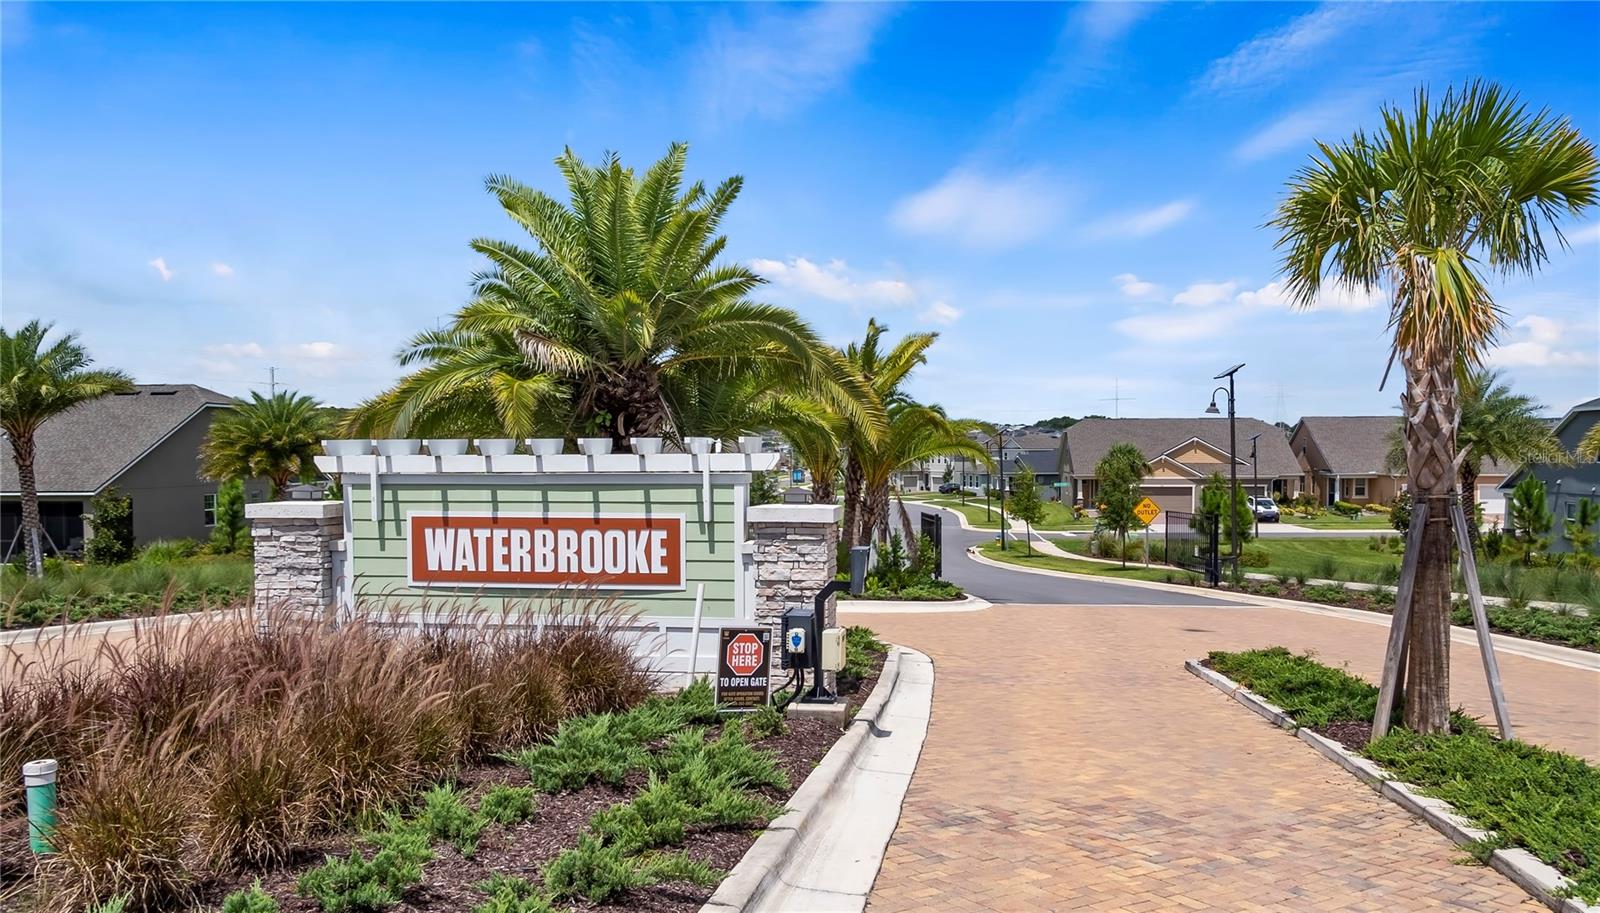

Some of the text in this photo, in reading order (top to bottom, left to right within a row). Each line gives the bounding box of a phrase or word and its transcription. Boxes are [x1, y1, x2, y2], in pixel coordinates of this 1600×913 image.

[424, 527, 668, 574] WATERBROOKE
[733, 642, 758, 654] STOP
[732, 655, 758, 667] HERE
[720, 677, 767, 687] TO OPEN GATE
